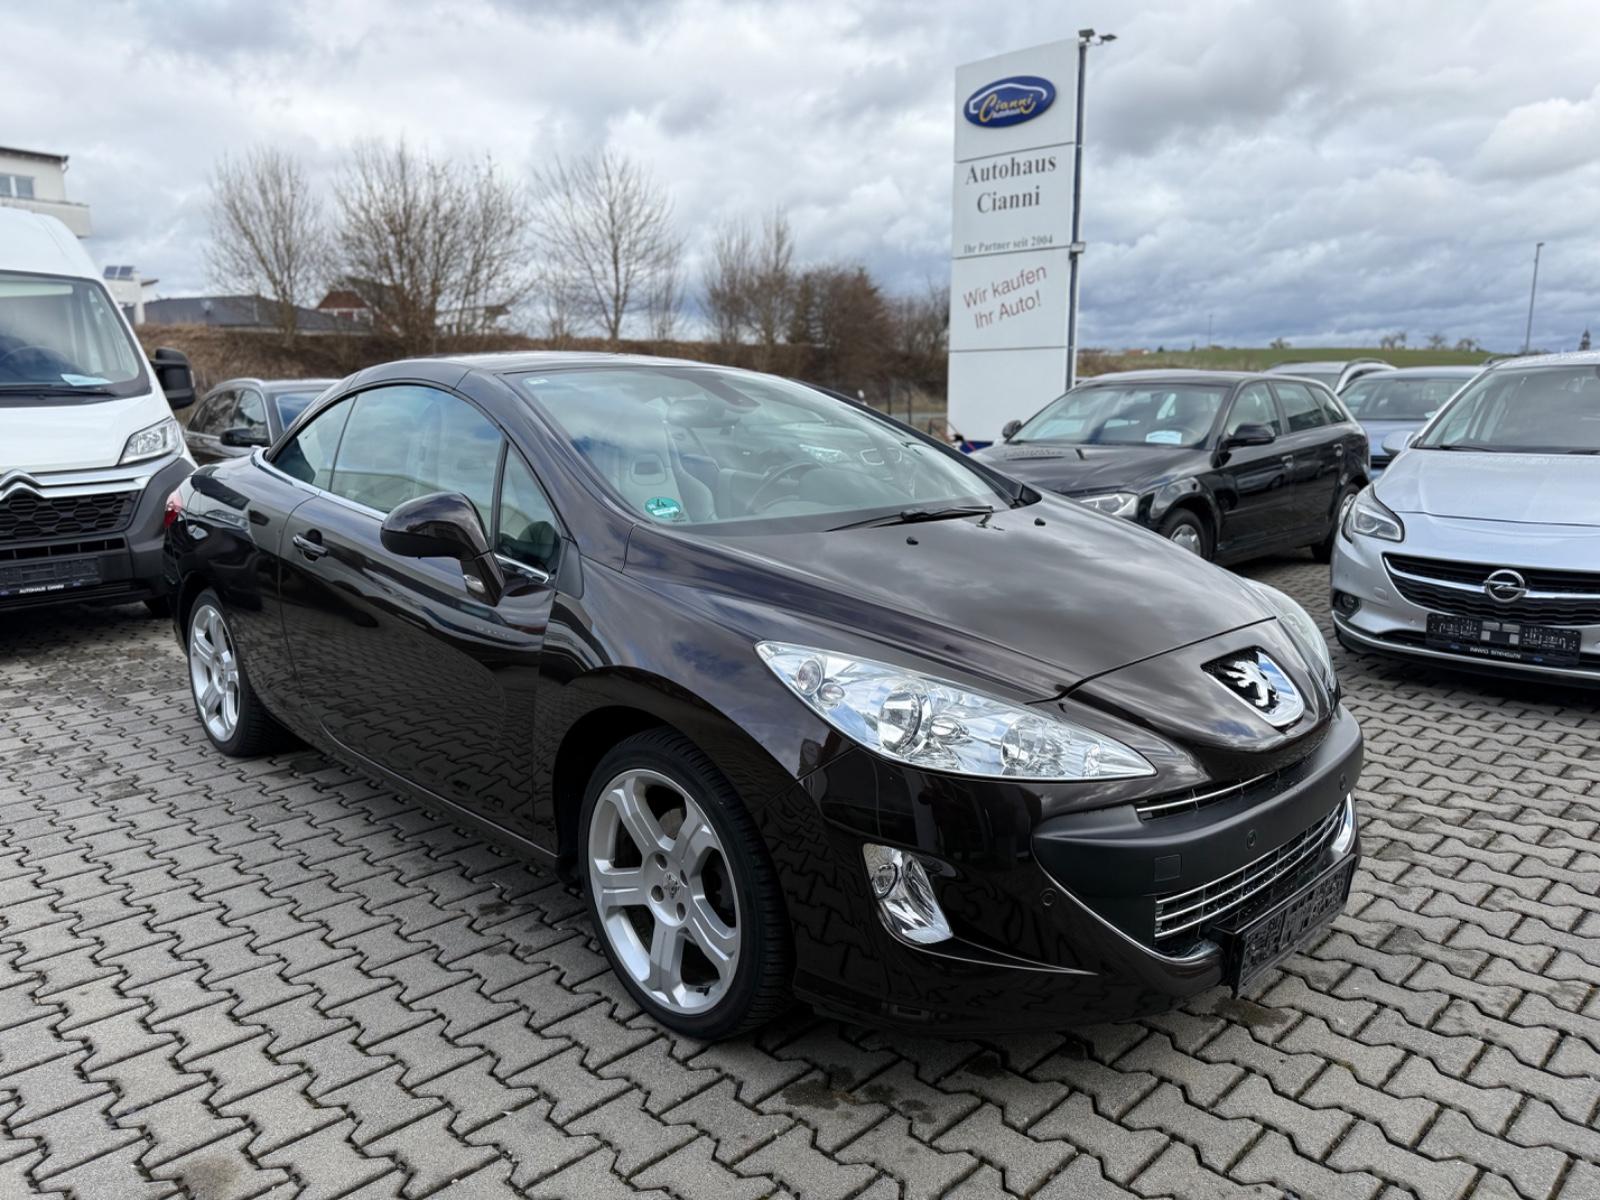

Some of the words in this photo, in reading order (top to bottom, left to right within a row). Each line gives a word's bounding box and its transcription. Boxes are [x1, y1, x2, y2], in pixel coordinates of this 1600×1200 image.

[979, 92, 1036, 122] Cianni
[966, 156, 1057, 185] Autohaus
[977, 186, 1040, 214] Cianni
[964, 243, 976, 254] Ihr
[978, 241, 1010, 253] Partner
[1013, 237, 1028, 248] seit
[1031, 234, 1053, 246] 2004
[963, 287, 987, 309] Wir
[991, 266, 1047, 298] kaufen
[974, 311, 995, 329] Ihr
[998, 290, 1041, 320] Auto!
